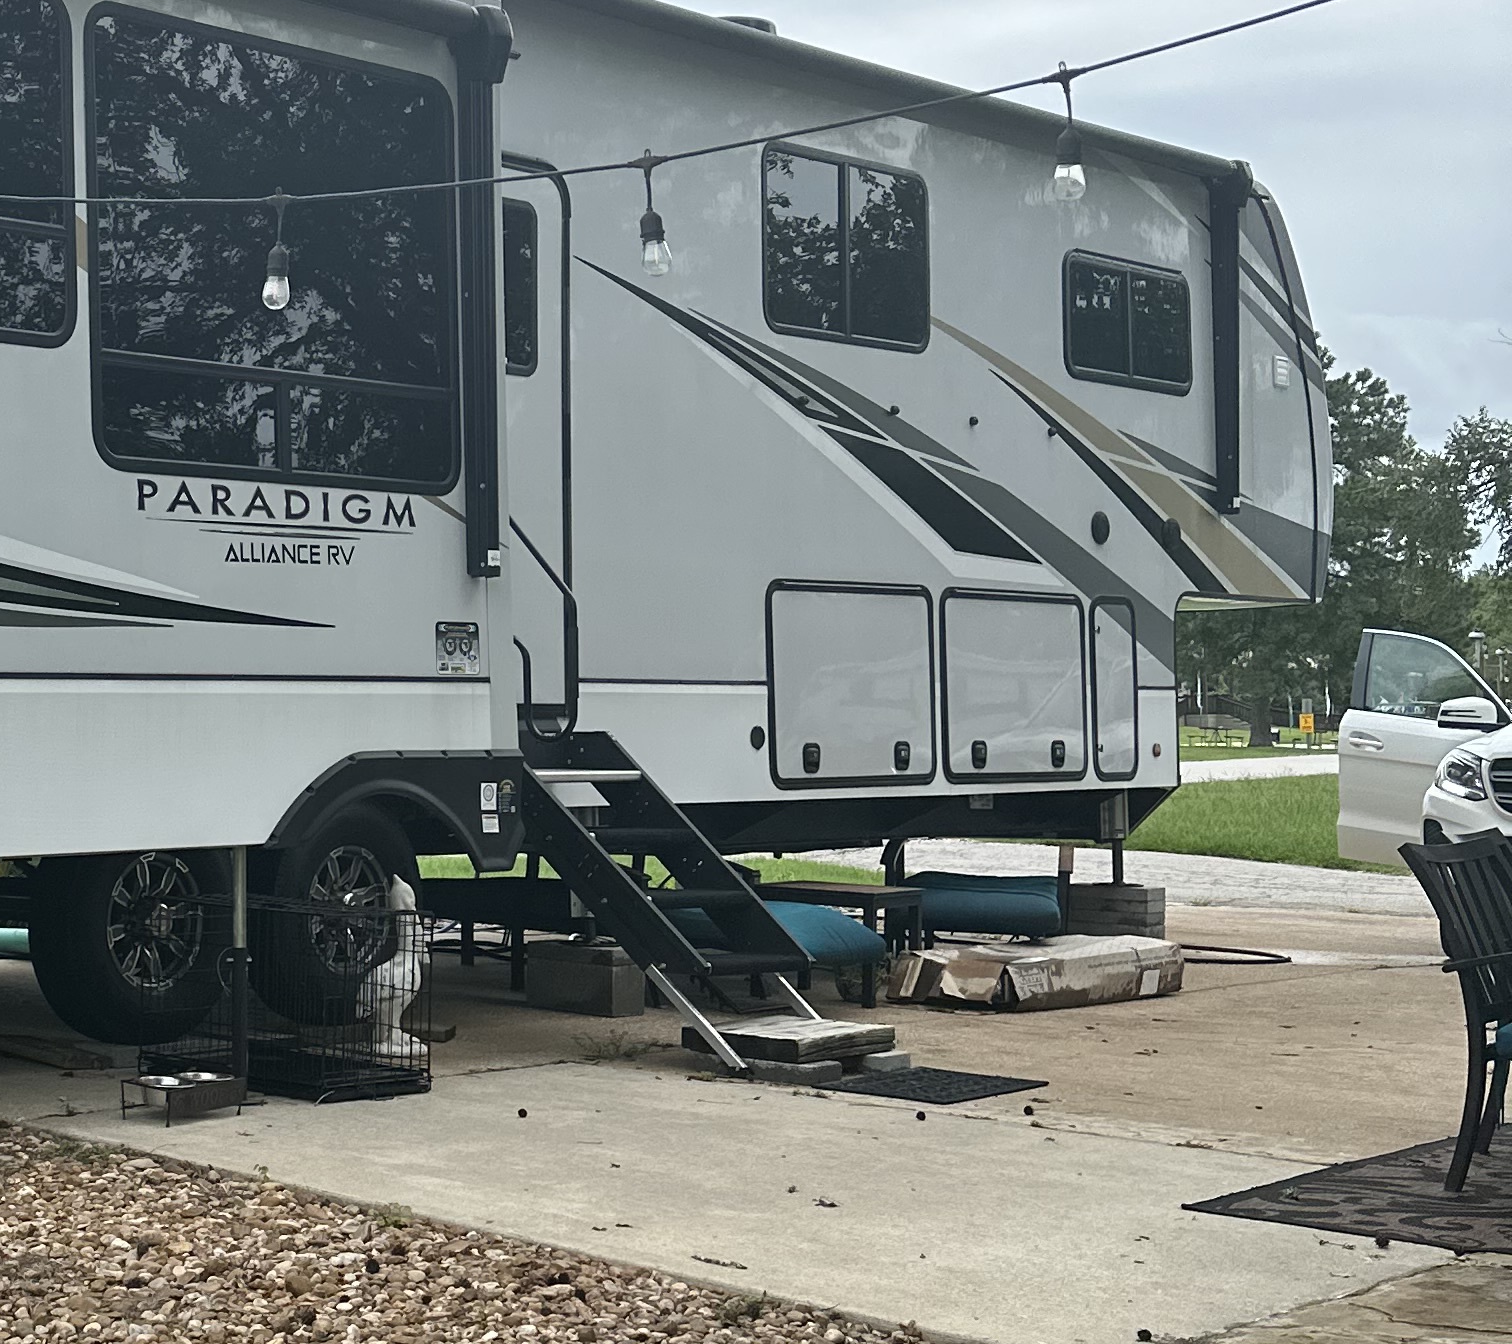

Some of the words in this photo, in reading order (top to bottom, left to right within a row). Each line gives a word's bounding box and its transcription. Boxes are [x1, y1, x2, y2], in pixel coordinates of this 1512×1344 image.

[136, 478, 417, 528] PARADIGM
[224, 541, 321, 565] ALLIANCE
[327, 544, 356, 566] RV
